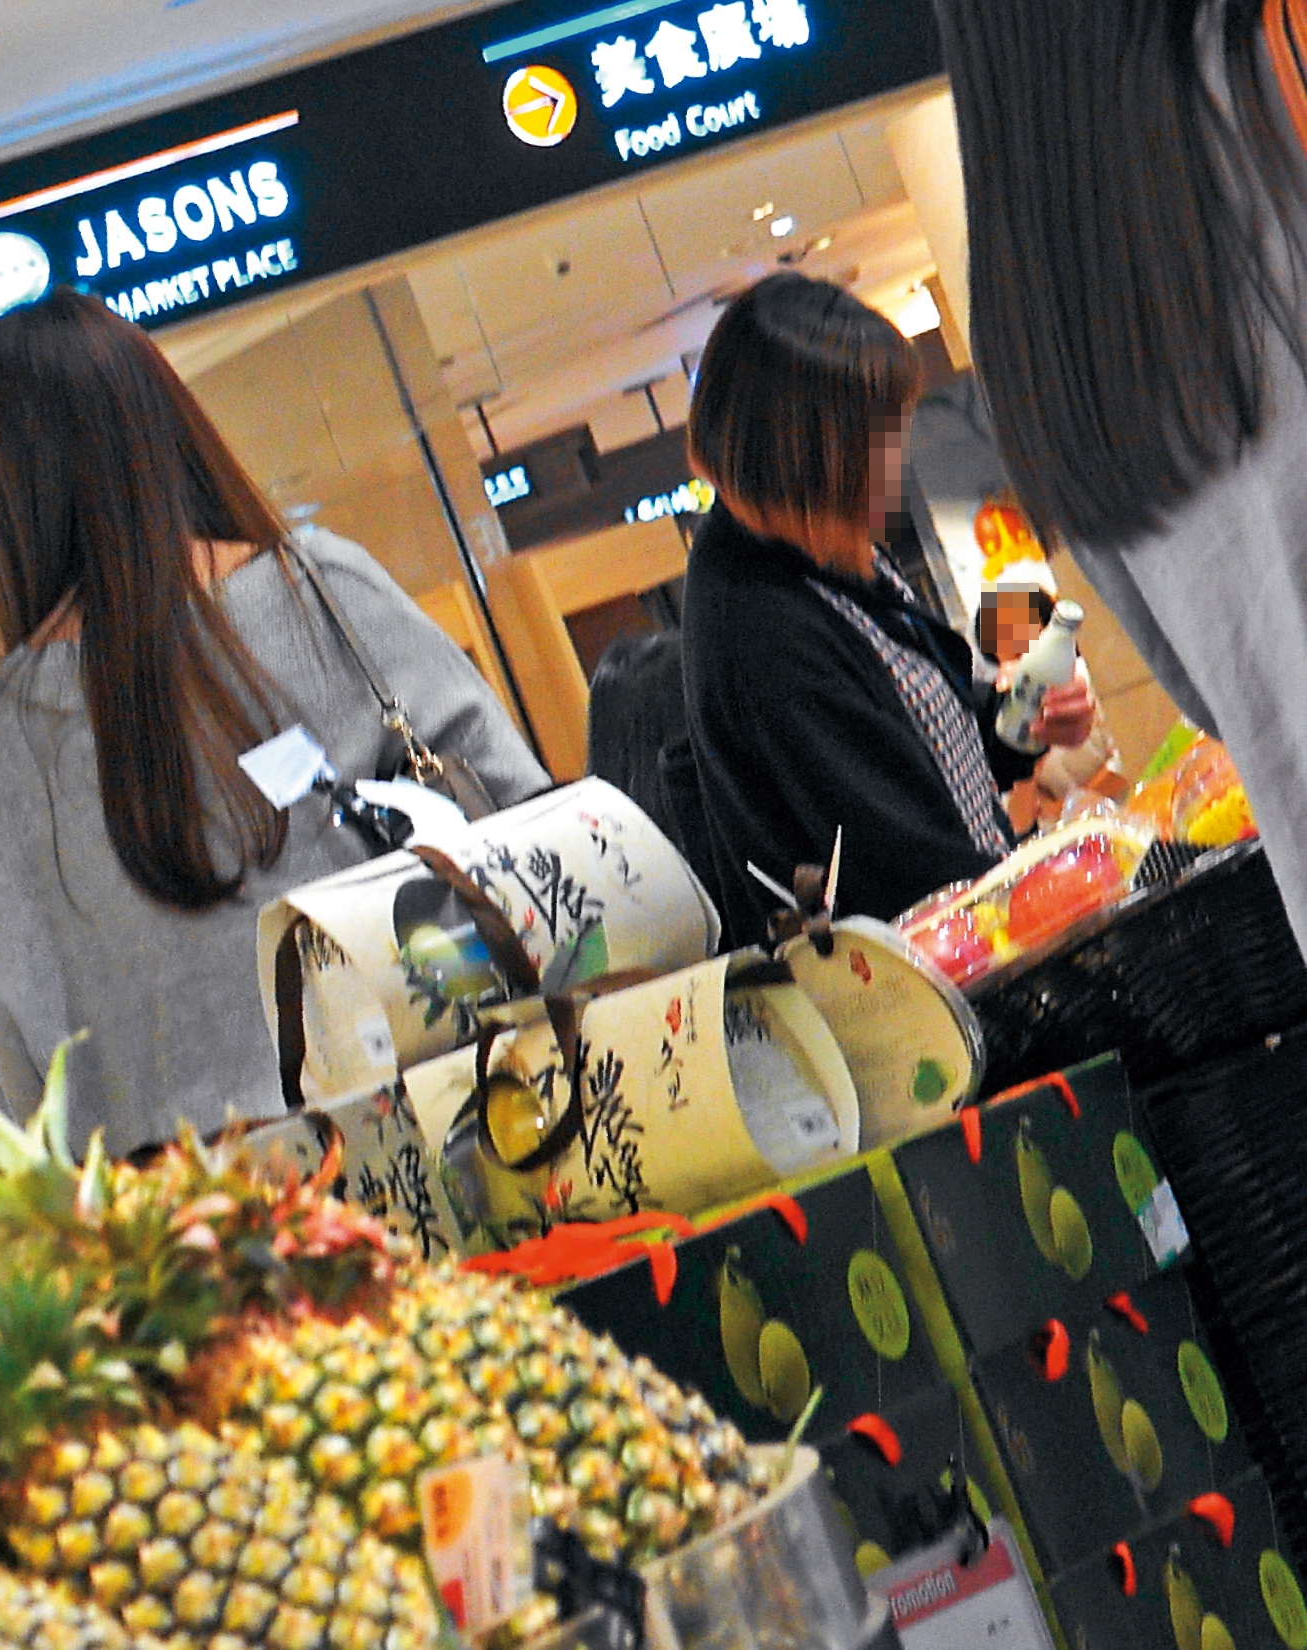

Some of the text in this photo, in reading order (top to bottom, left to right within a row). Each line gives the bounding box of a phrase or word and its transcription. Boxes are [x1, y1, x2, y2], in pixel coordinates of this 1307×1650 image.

[591, 0, 810, 108] 美食廣場
[614, 90, 761, 162] Food Court
[75, 161, 289, 278] JASONS
[105, 265, 210, 324] MARKET
[211, 238, 299, 293] PLACE
[891, 1569, 956, 1620] romotion
